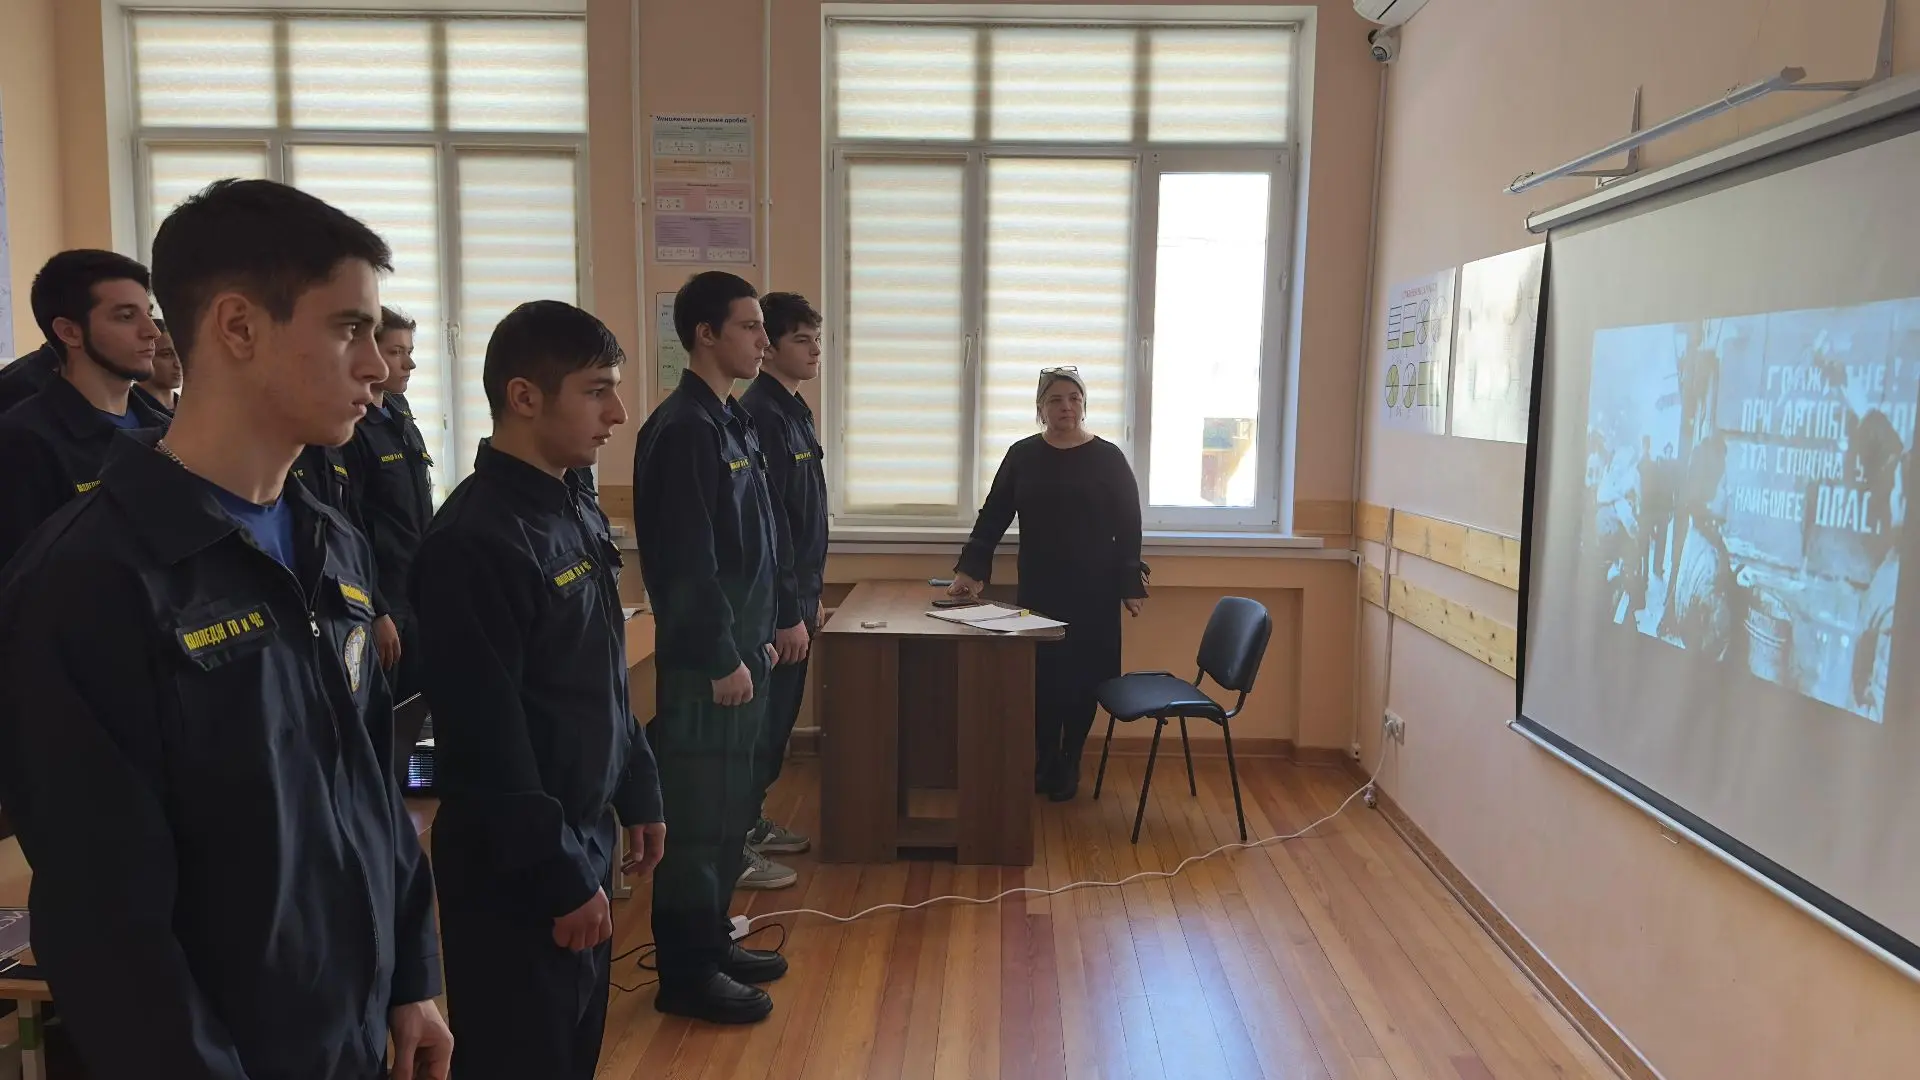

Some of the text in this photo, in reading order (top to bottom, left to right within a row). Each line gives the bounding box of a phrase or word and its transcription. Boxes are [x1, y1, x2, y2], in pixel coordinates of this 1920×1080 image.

[1741, 399, 1773, 434] ПРИ
[1739, 442, 1767, 472] ЭТА
[1776, 446, 1845, 481] СТОРОНА
[1734, 486, 1804, 522] НАИБОЛЕЕ
[183, 622, 228, 651] КОЛЛЕДЖ
[227, 619, 241, 637] ГО
[248, 611, 265, 629] ЧС
